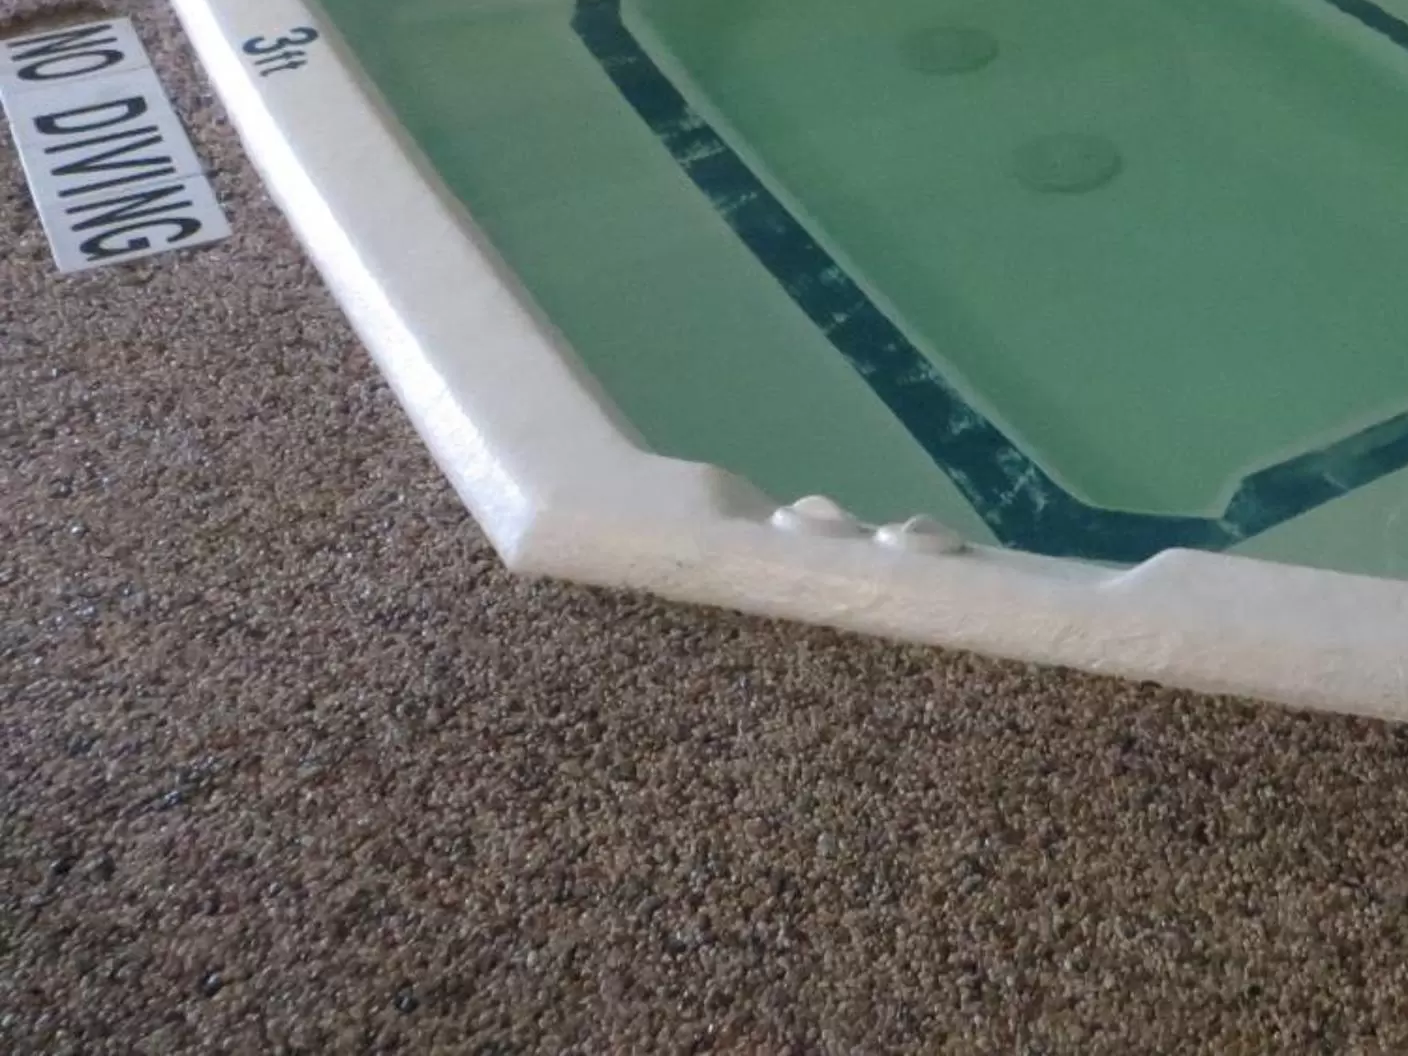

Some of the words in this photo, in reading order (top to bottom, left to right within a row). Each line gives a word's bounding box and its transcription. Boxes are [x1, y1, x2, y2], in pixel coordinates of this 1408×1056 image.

[0, 23, 125, 81] NO
[242, 25, 320, 78] 3ft
[33, 95, 203, 262] DIVING
